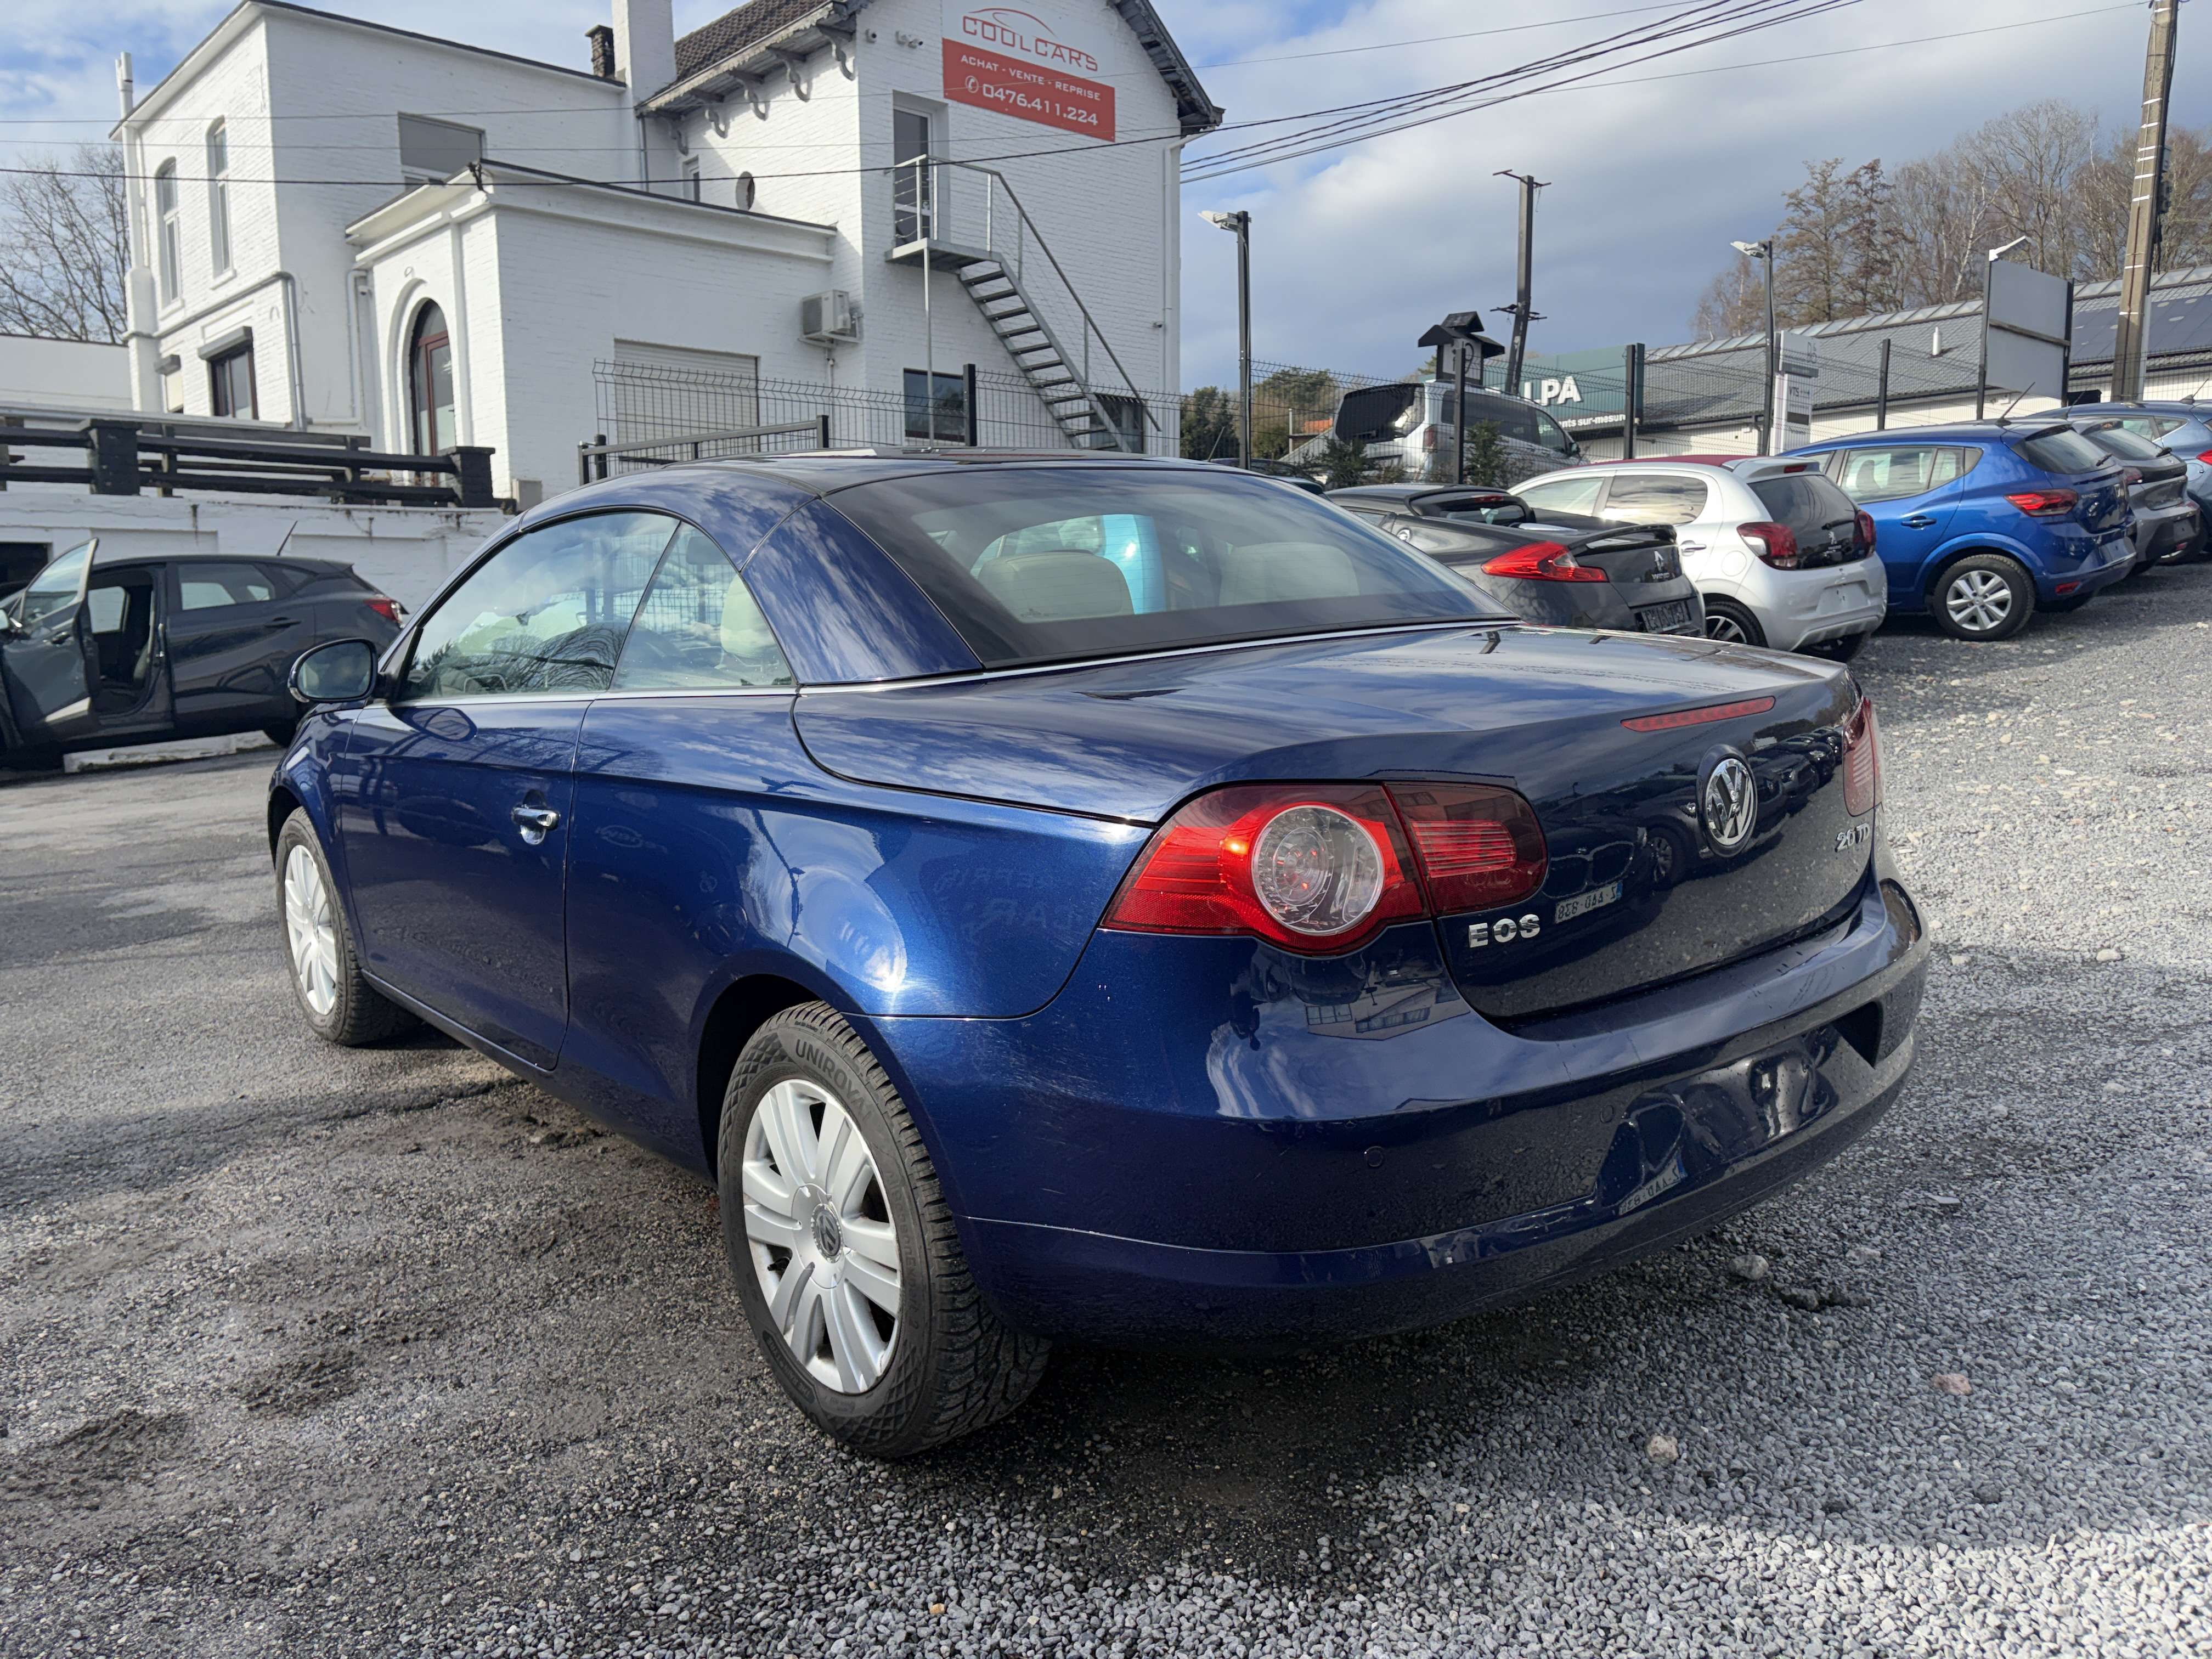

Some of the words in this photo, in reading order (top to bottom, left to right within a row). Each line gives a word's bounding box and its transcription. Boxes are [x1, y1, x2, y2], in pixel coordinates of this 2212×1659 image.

[963, 15, 1098, 71] COOLCARS
[961, 54, 999, 72] ACHAT
[1009, 67, 1045, 85] VENTE
[1055, 81, 1101, 101] REPRISE
[983, 83, 1098, 126] 0476.411.224
[1468, 913, 1541, 948] EOS
[795, 1039, 872, 1121] UNIROYAL
